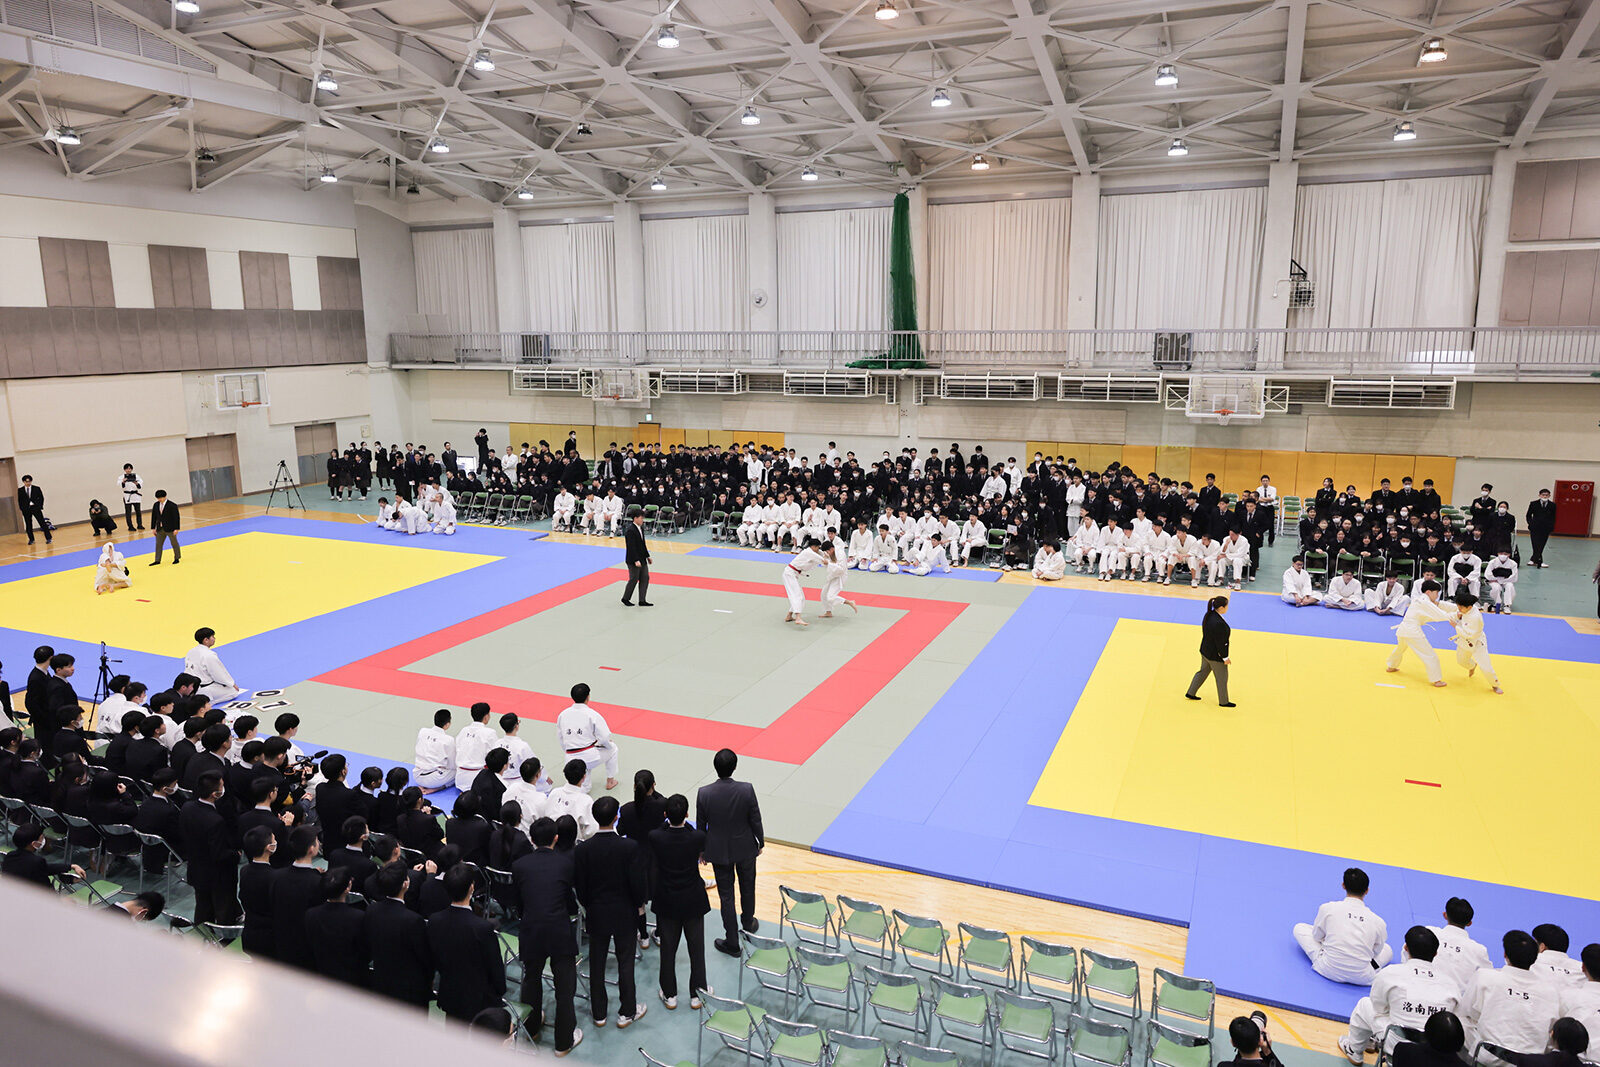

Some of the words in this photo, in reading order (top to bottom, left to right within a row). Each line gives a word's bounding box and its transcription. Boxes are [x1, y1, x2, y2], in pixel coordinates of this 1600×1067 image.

[228, 701, 252, 709] 10
[1443, 942, 1461, 953] 1-5
[1414, 968, 1434, 978] 1-5
[1550, 966, 1571, 975] 1-5
[1508, 988, 1530, 1000] 1-5
